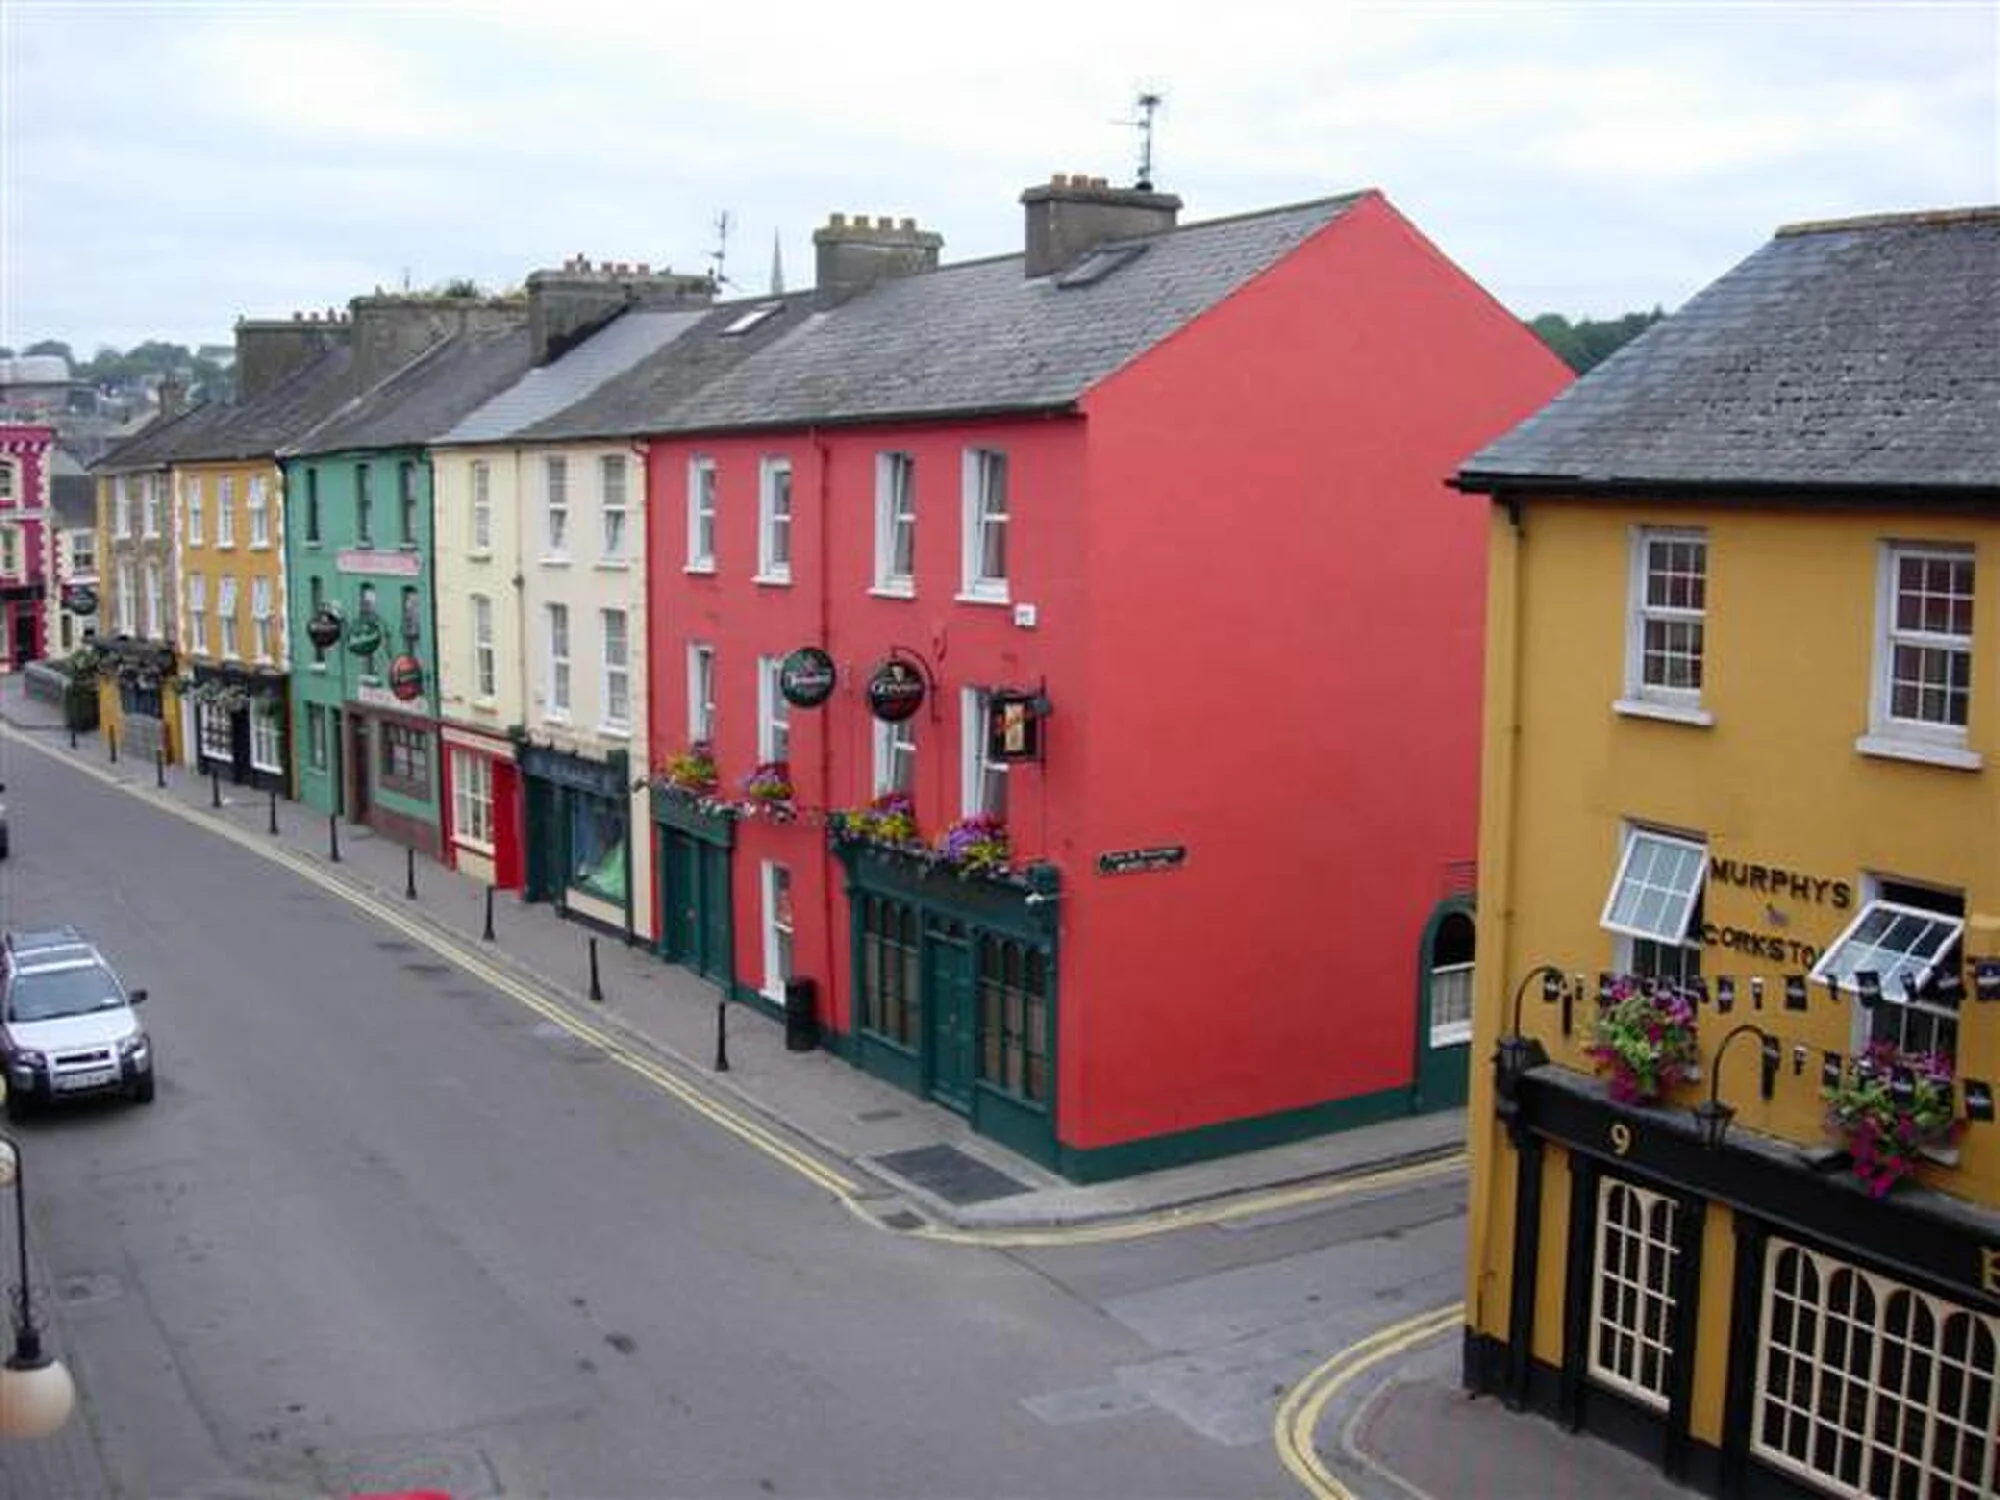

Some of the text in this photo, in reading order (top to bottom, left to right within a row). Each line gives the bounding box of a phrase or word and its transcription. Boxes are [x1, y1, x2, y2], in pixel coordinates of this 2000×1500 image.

[1710, 857, 1851, 909] MURPHYS
[1702, 924, 1826, 971] CORKSTO
[1610, 1123, 1631, 1155] 9
